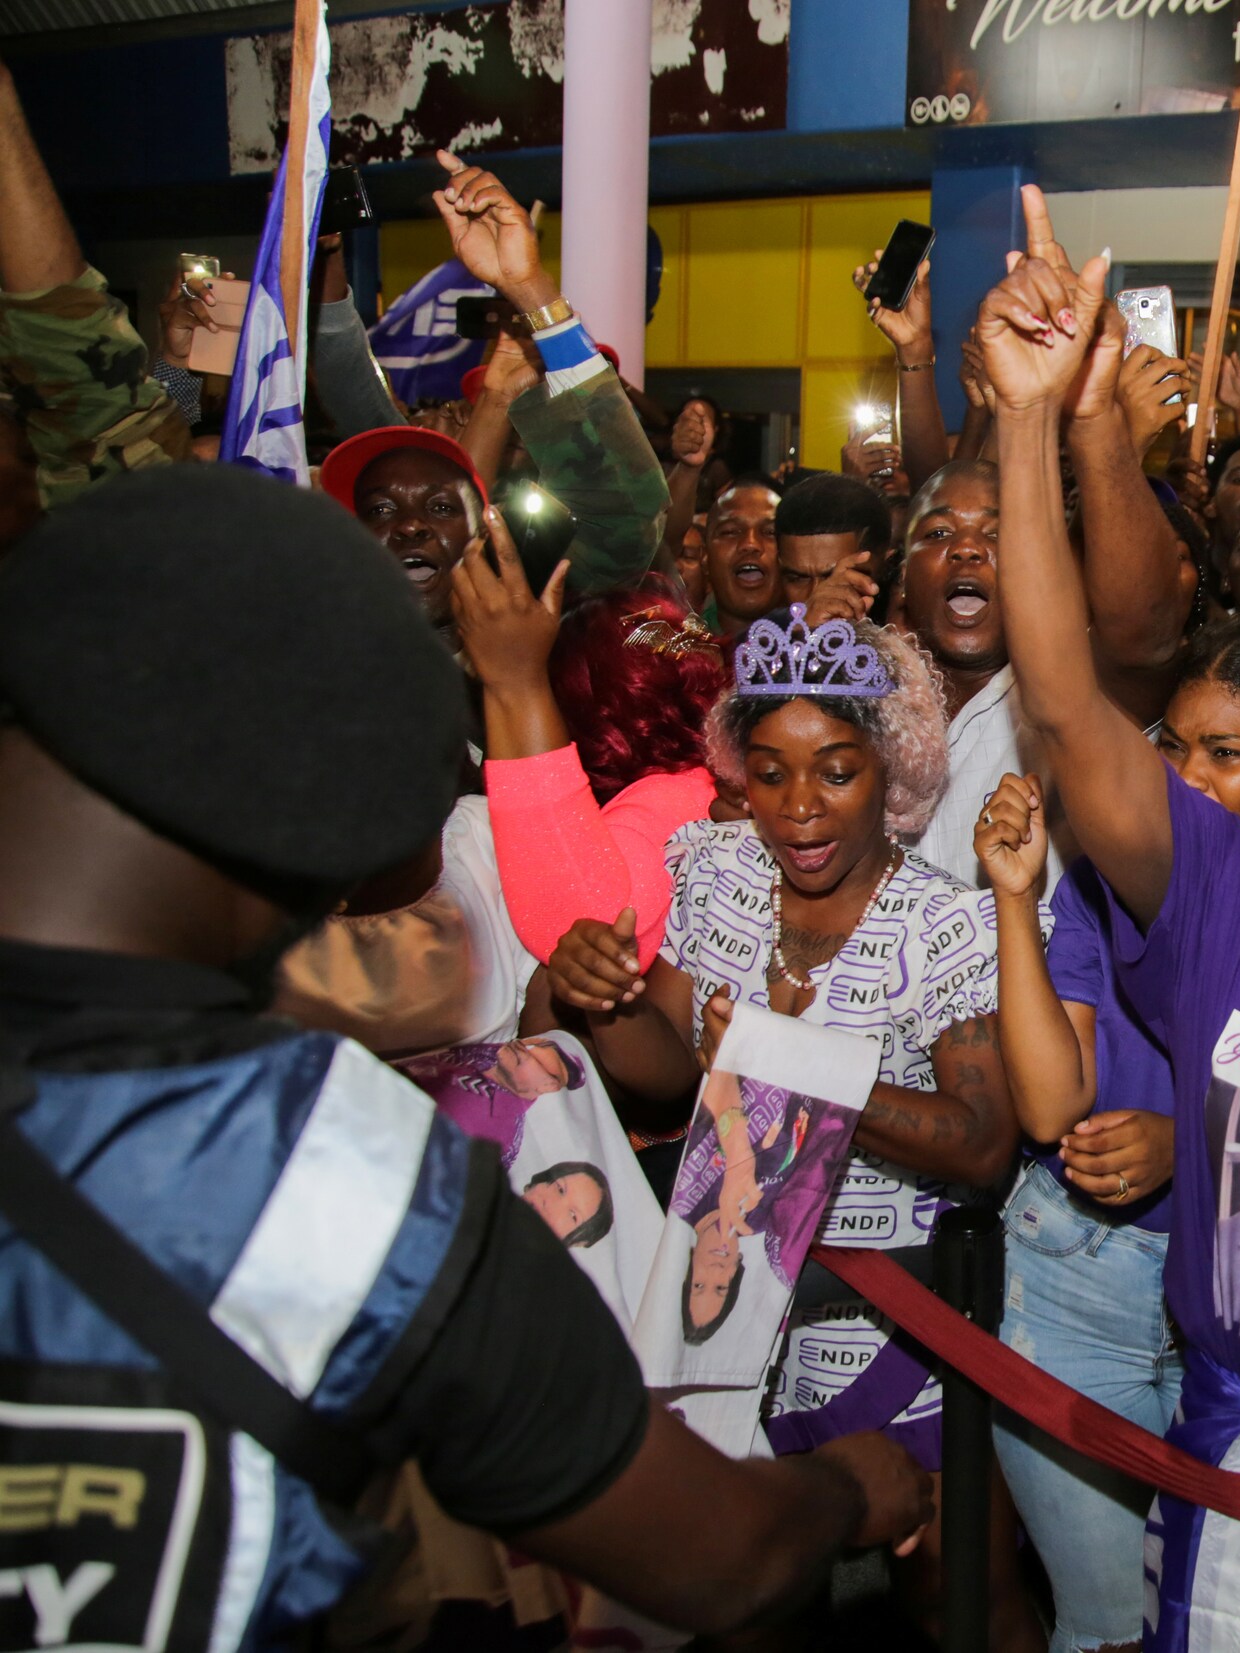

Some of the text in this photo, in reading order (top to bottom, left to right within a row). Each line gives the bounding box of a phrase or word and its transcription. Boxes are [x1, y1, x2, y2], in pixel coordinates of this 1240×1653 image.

[732, 887, 771, 915] NDP
[708, 928, 752, 958] NDP
[927, 921, 965, 962] NDP
[839, 1215, 890, 1231] NDP
[820, 1350, 872, 1367] NDP
